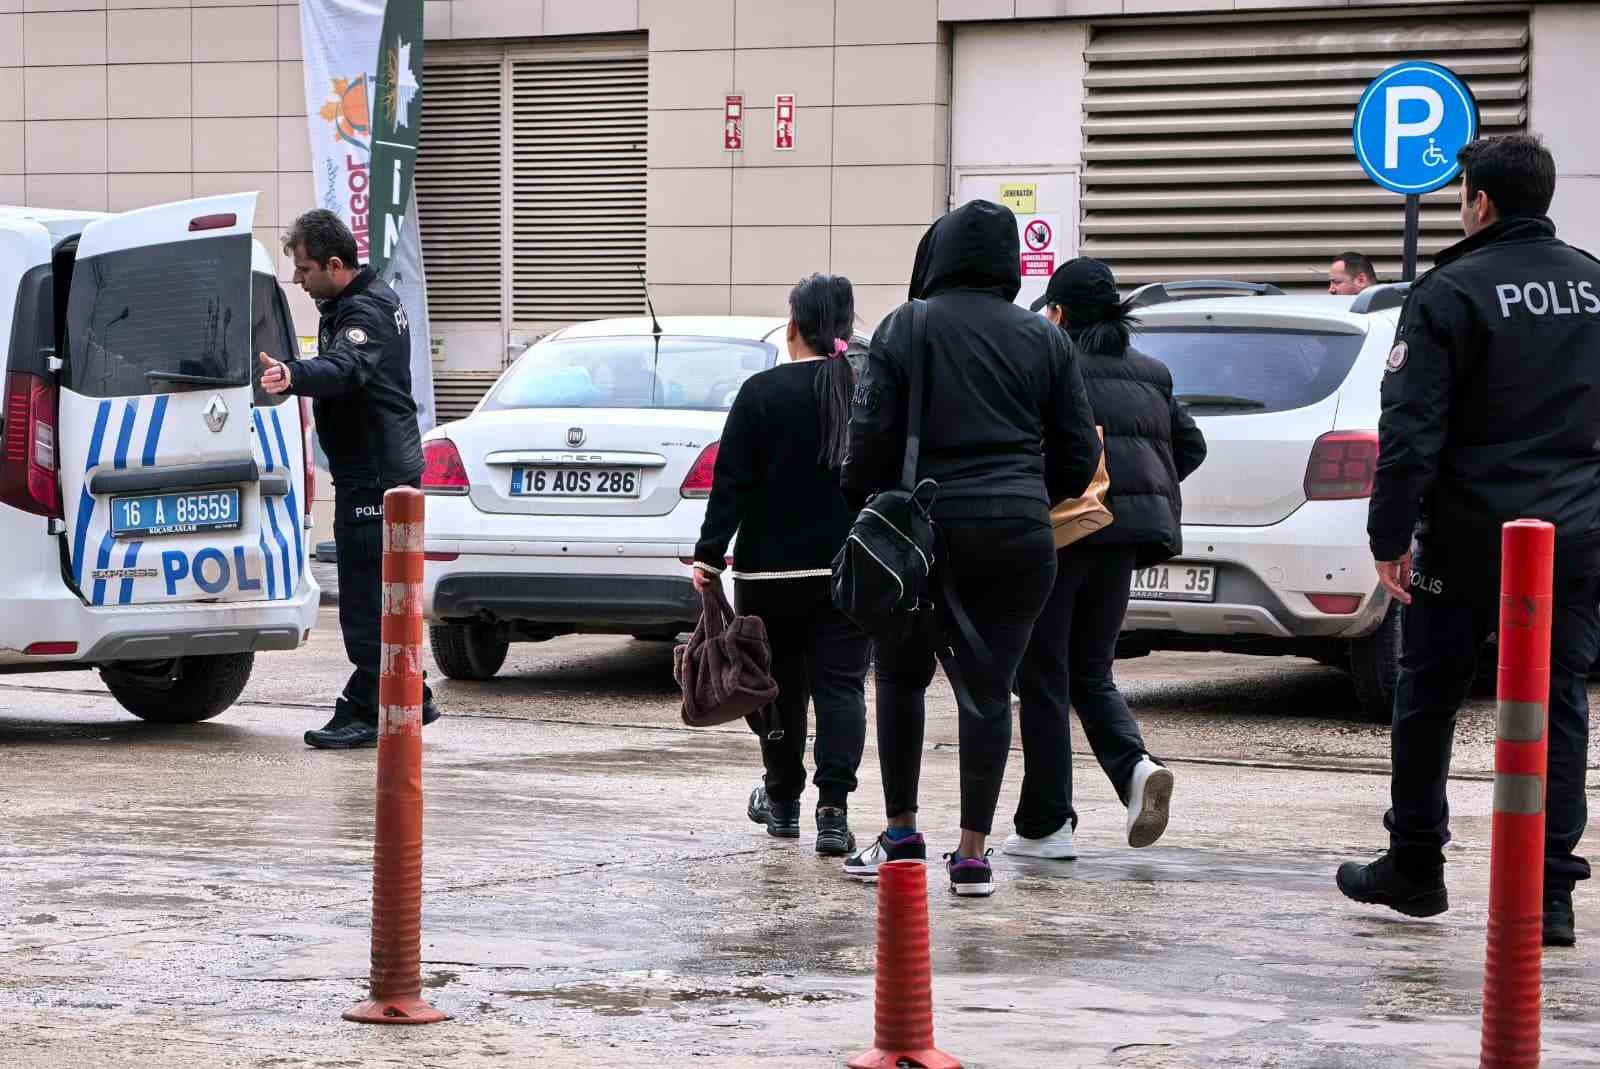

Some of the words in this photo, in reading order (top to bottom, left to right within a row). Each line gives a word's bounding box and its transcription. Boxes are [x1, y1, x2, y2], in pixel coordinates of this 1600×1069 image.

[1384, 86, 1445, 169] P
[525, 471, 546, 491] 16
[552, 471, 591, 492] AOS
[596, 472, 635, 493] 286
[123, 501, 141, 526] 16
[155, 498, 166, 524] A
[176, 494, 231, 522] 85559
[91, 568, 158, 578] EXPRESS
[162, 546, 261, 595] POL
[1185, 568, 1211, 591] 35
